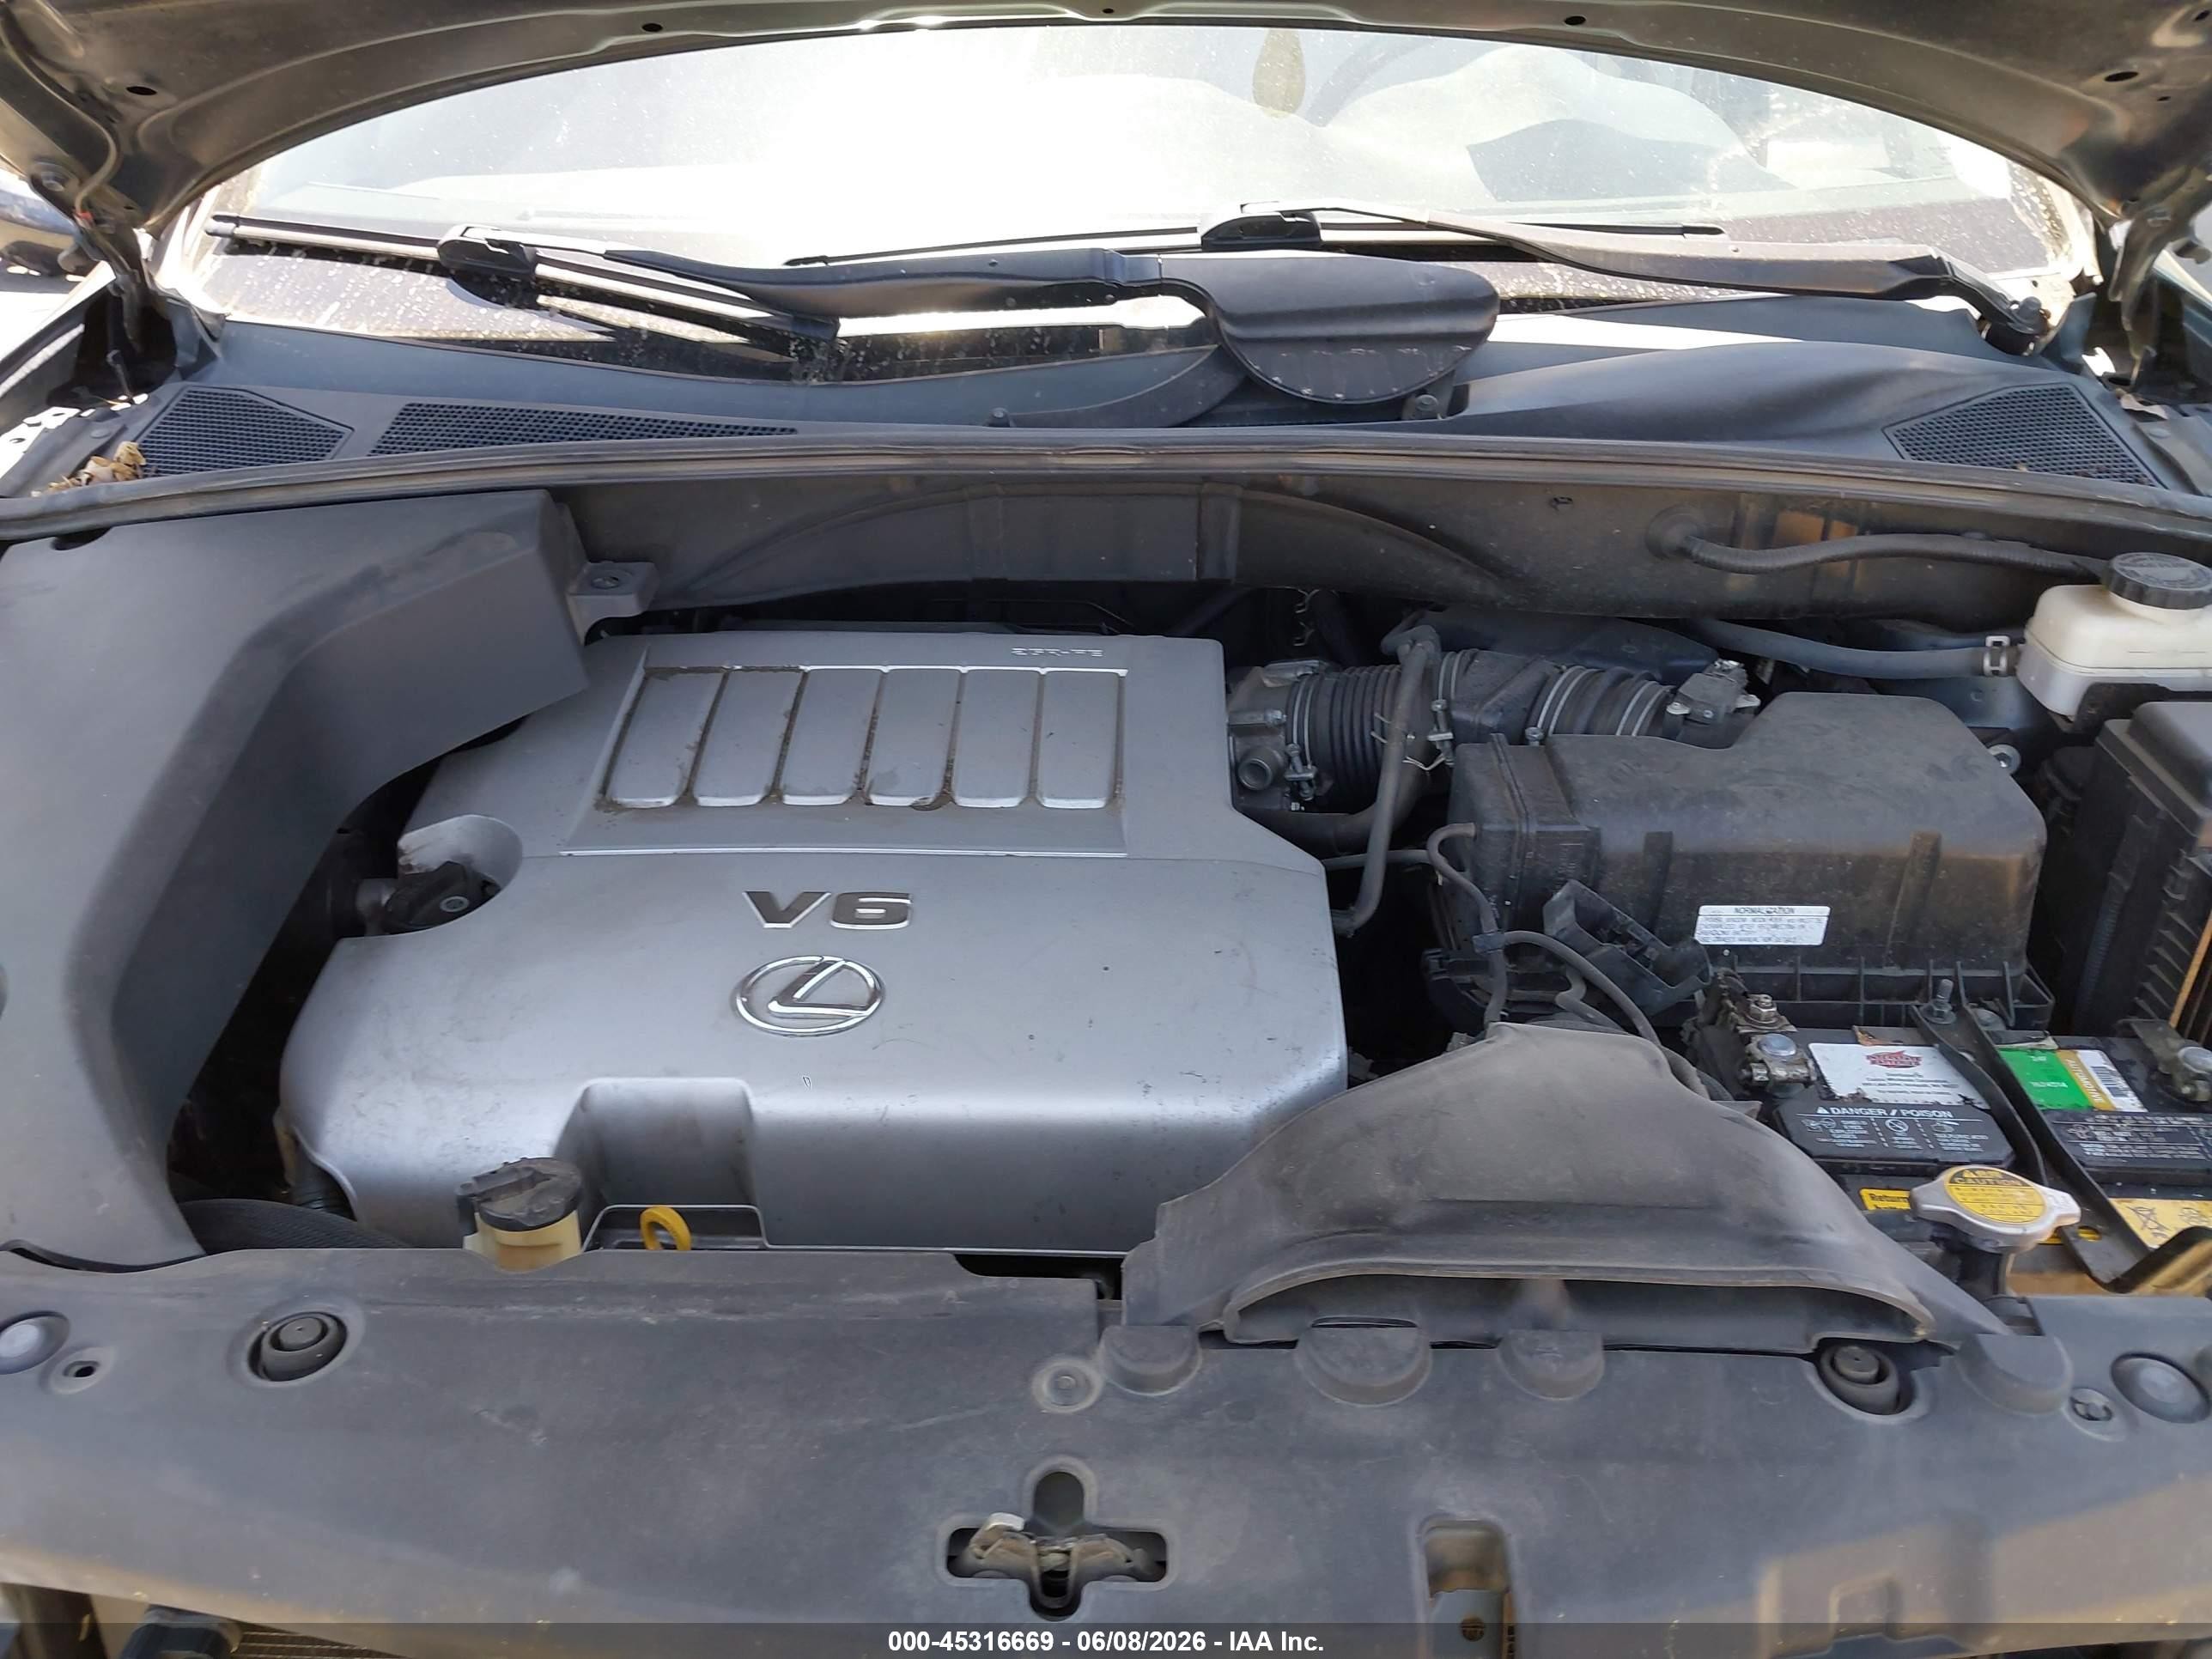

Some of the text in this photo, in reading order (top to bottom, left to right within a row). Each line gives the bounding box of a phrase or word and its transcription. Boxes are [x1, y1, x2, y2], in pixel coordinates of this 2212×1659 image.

[744, 890, 914, 930] V6
[1829, 1107, 1887, 1116] DANGER
[1900, 1109, 1954, 1118] POISON
[1954, 1176, 2022, 1187] CAUTION
